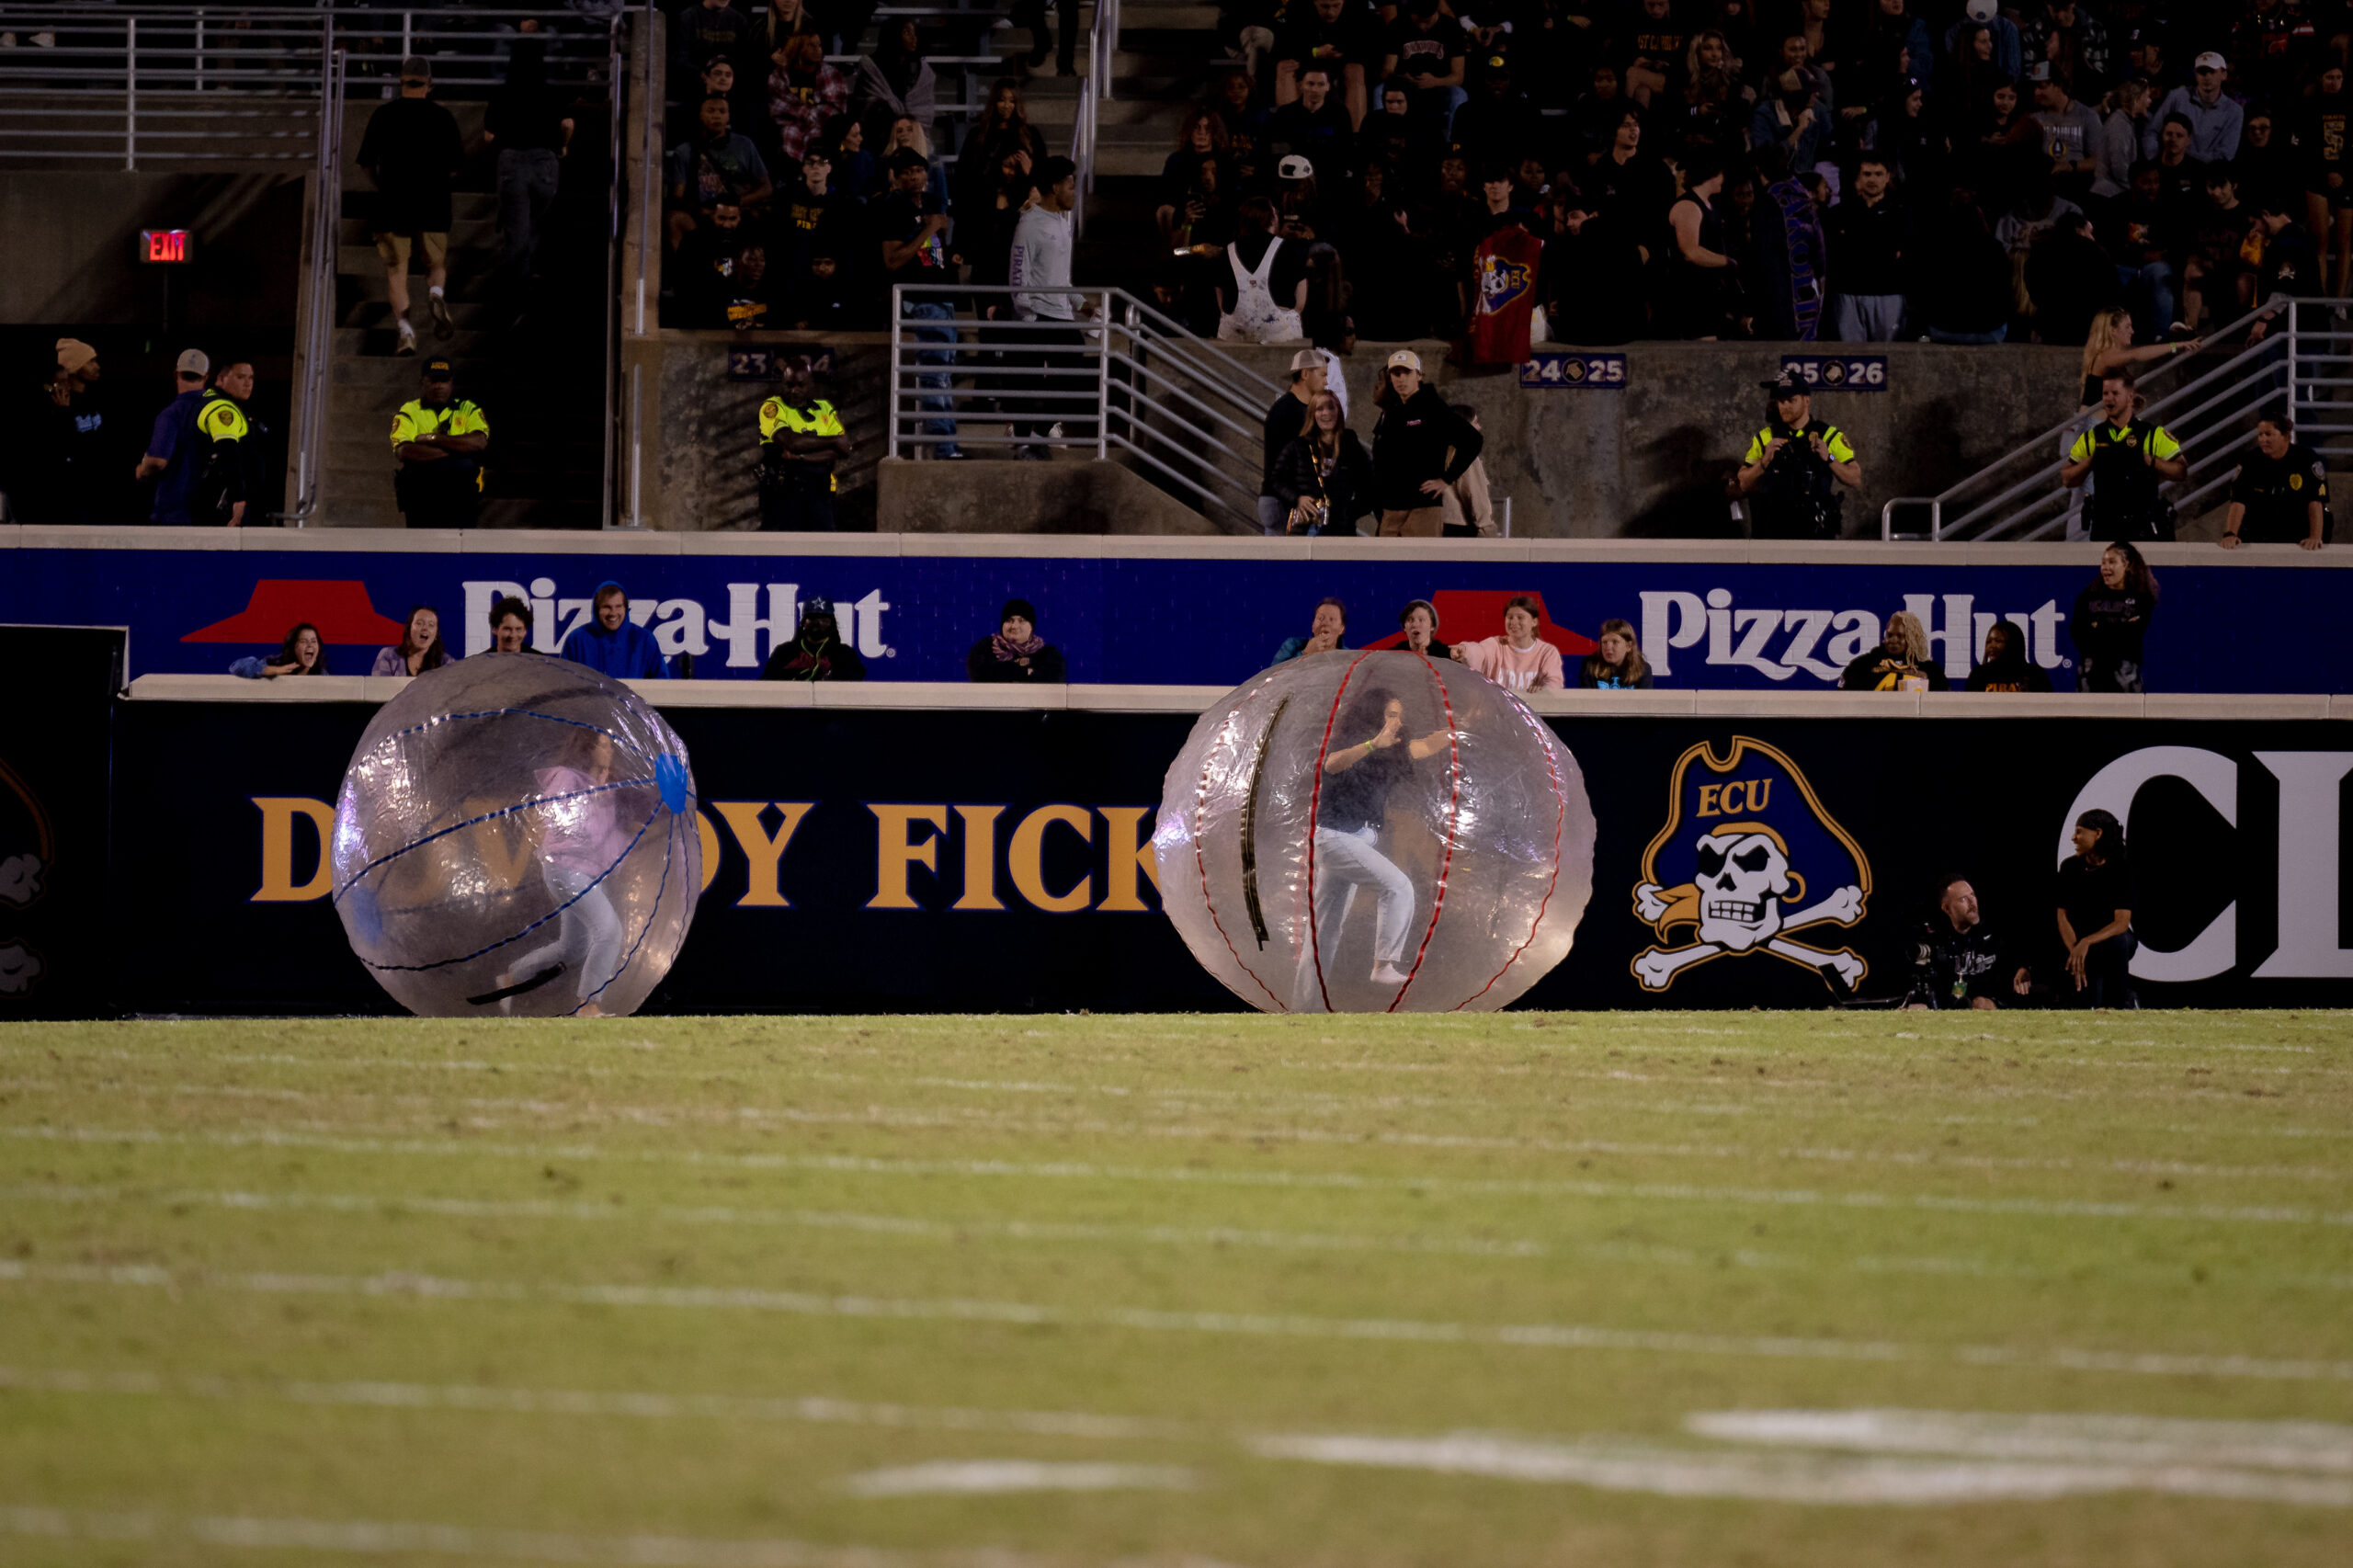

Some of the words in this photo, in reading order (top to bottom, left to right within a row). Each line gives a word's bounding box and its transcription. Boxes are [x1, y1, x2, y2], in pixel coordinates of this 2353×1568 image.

[2324, 121, 2345, 160] 5
[149, 232, 187, 261] EXIT
[1012, 245, 1024, 298] PIRAT
[733, 353, 767, 375] 23
[1524, 359, 1561, 381] 24
[1588, 359, 1623, 382] 25
[1848, 362, 1884, 384] 26
[709, 583, 890, 667] Ht
[1639, 587, 1881, 681] Pizza
[1694, 778, 1773, 817] ECU
